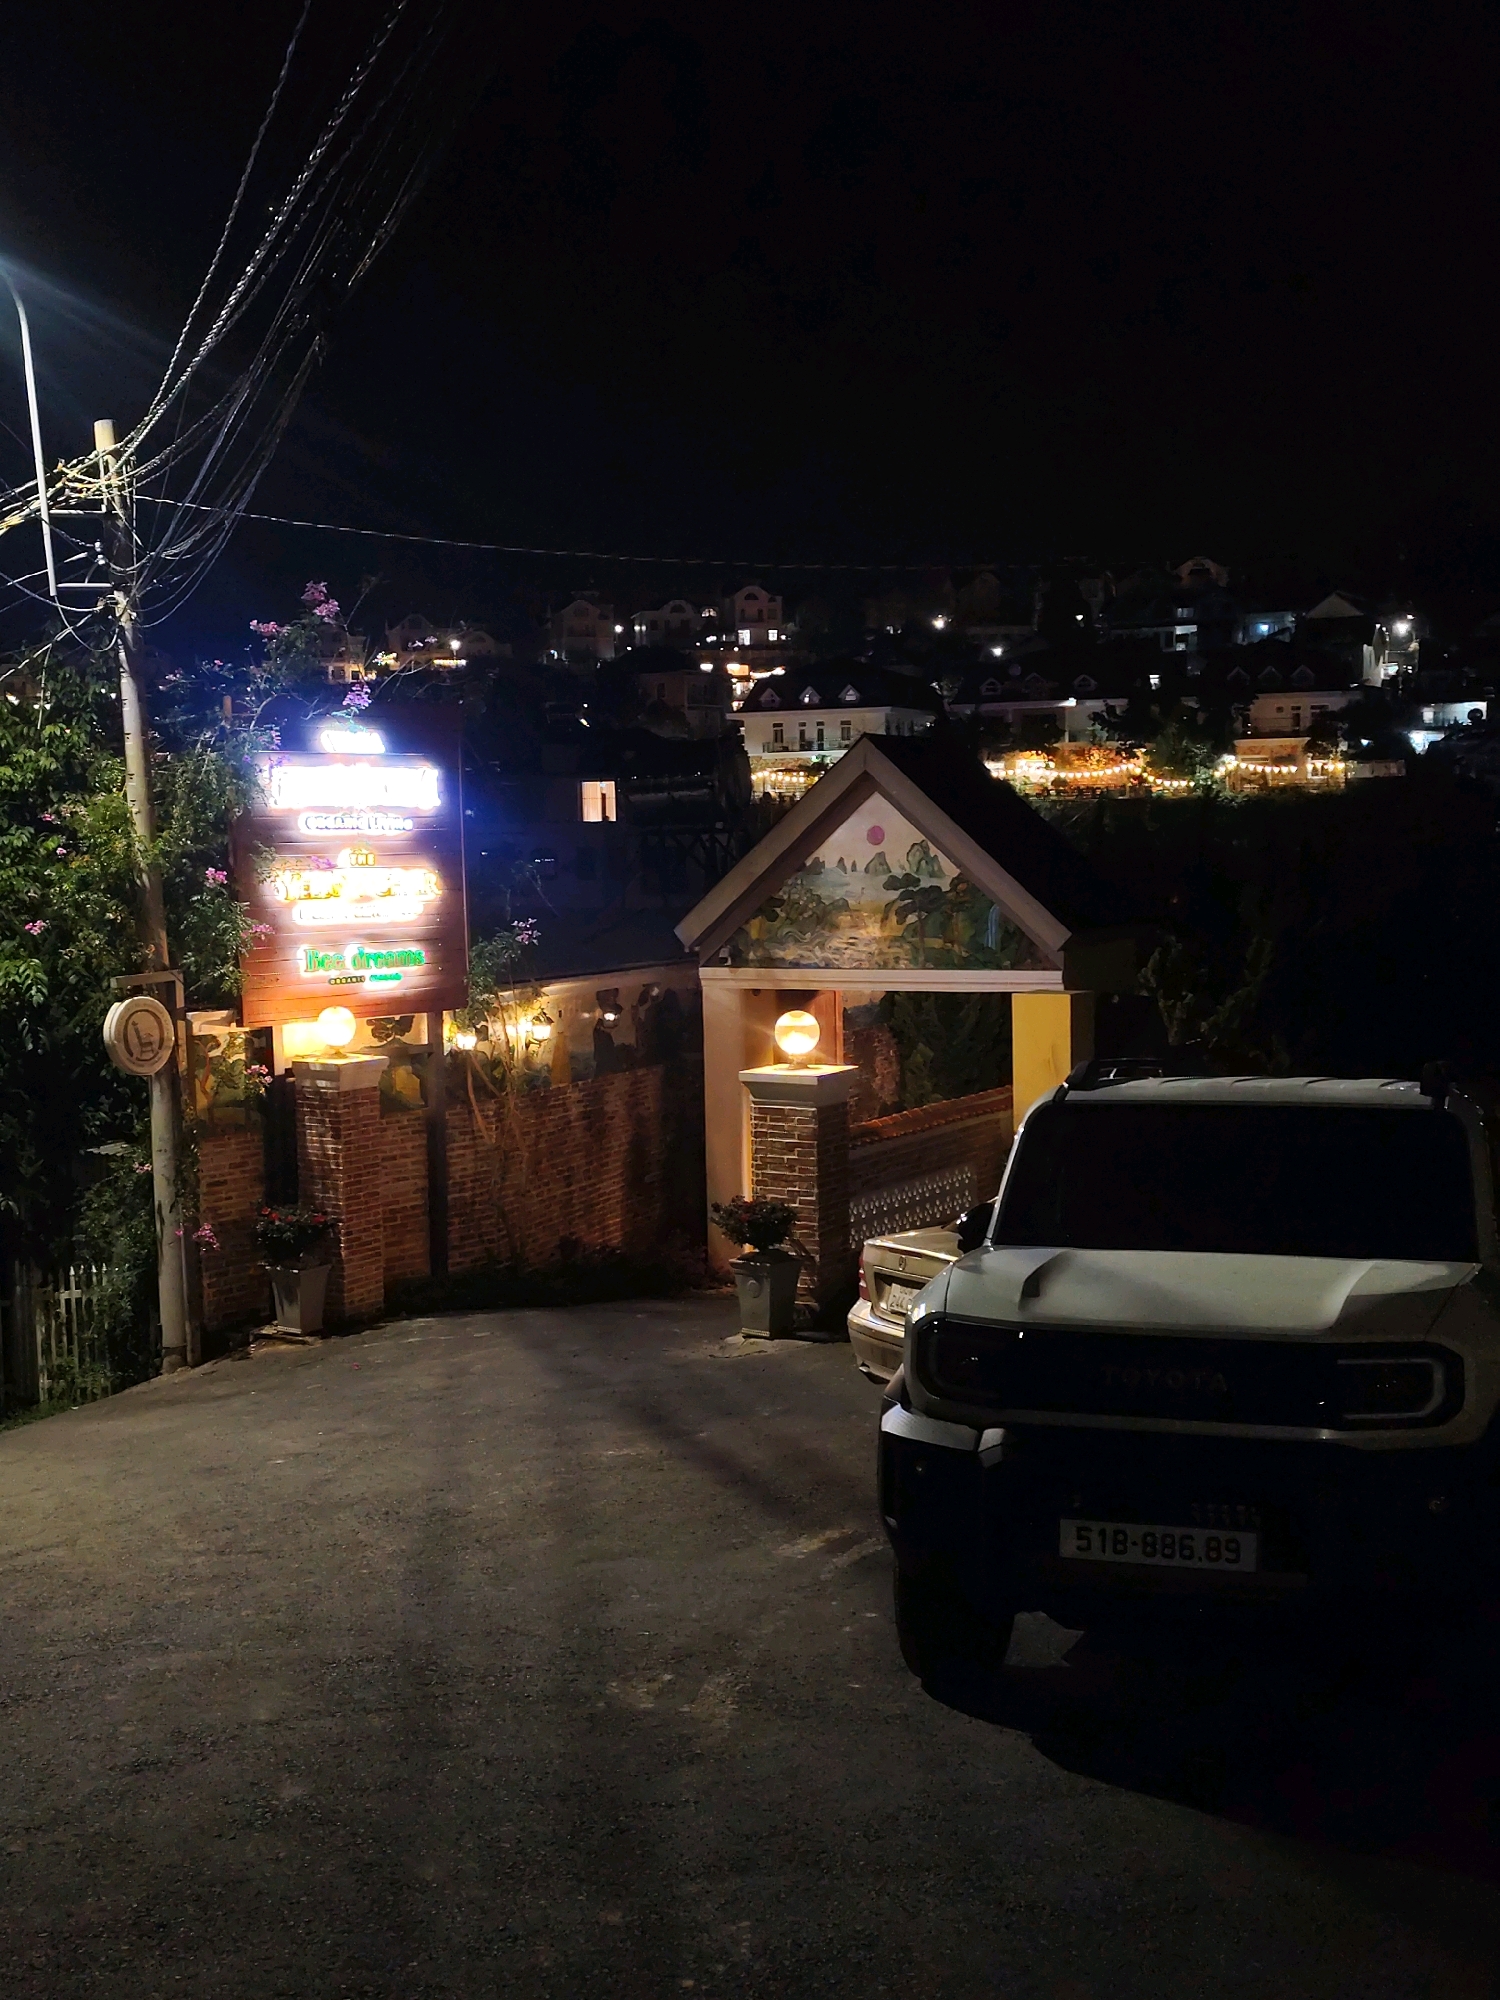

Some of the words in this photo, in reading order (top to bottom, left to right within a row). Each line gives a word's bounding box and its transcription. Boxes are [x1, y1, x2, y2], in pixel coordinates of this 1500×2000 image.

[348, 852, 376, 867] THE
[304, 949, 346, 972] Bee
[351, 946, 426, 970] dreams
[1102, 1366, 1229, 1391] TOYOTA
[1075, 1526, 1241, 1564] 51B-886.89
